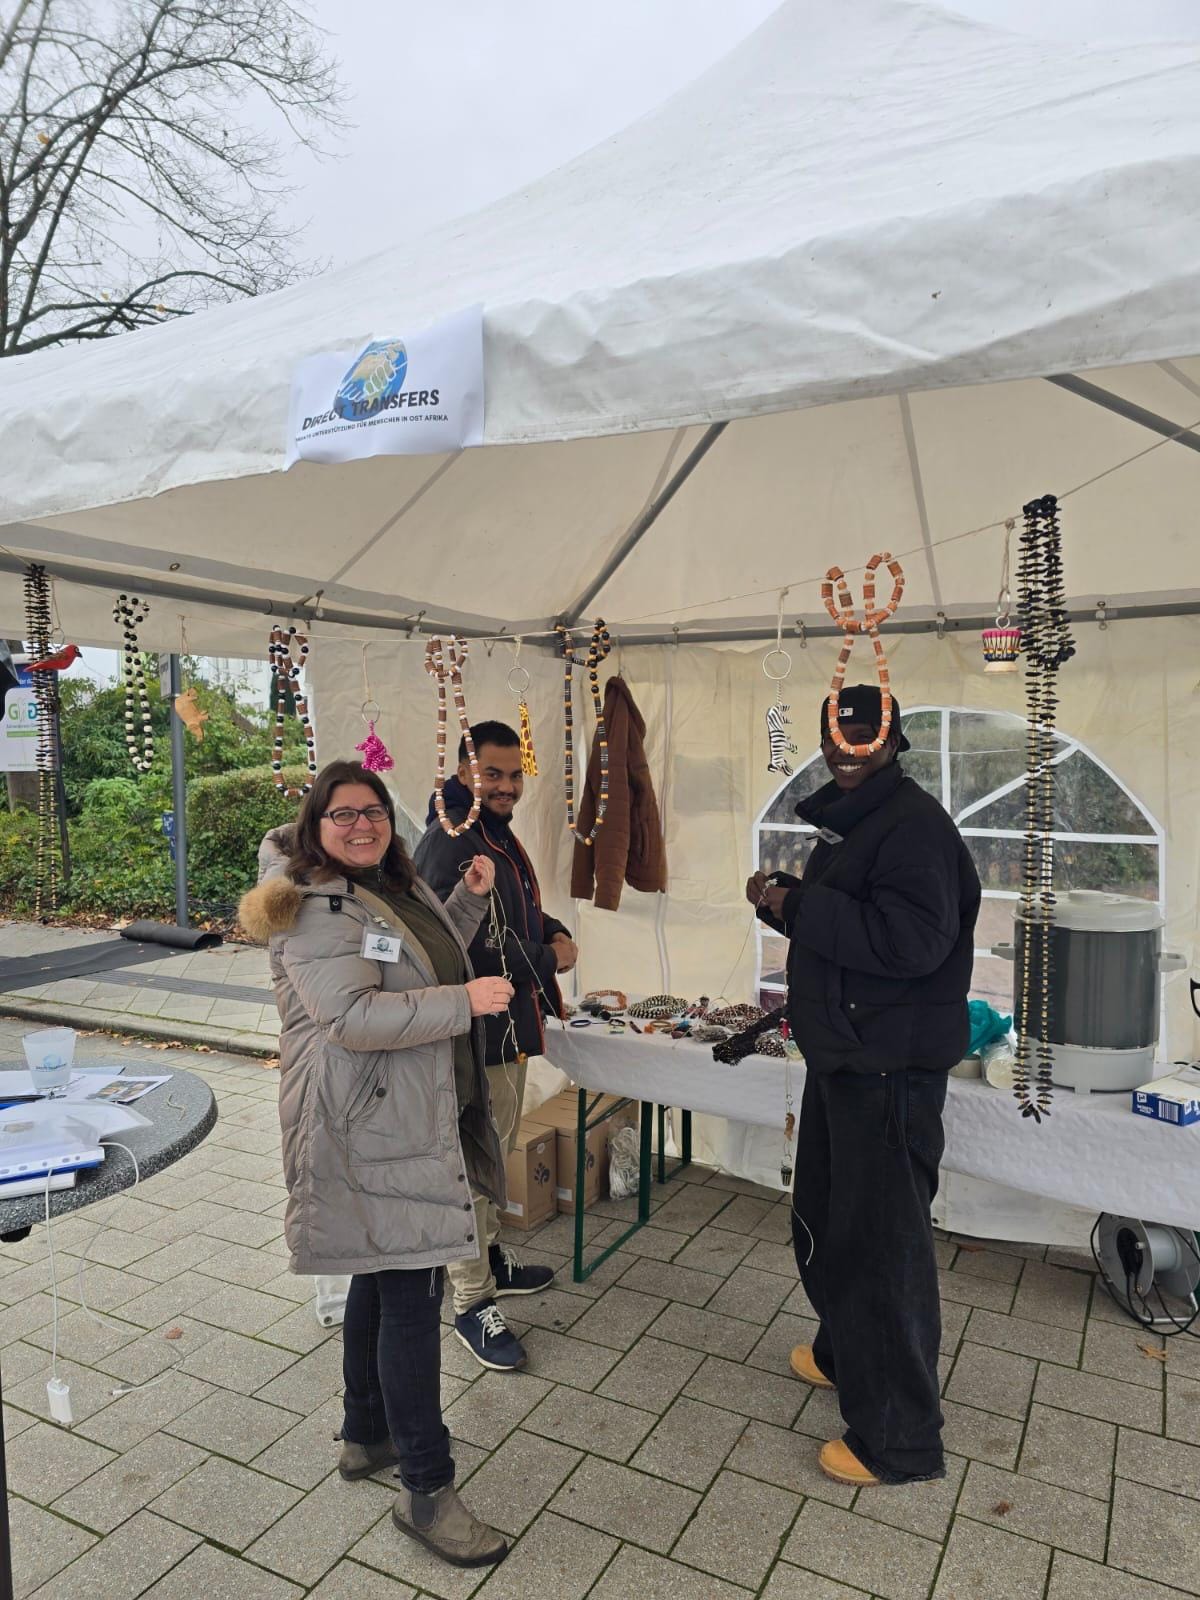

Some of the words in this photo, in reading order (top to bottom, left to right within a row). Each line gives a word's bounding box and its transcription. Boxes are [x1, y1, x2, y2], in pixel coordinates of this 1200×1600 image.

[302, 405, 346, 431] DIRECT
[352, 389, 440, 417] TRANSFERS
[425, 414, 449, 422] AFRIKA
